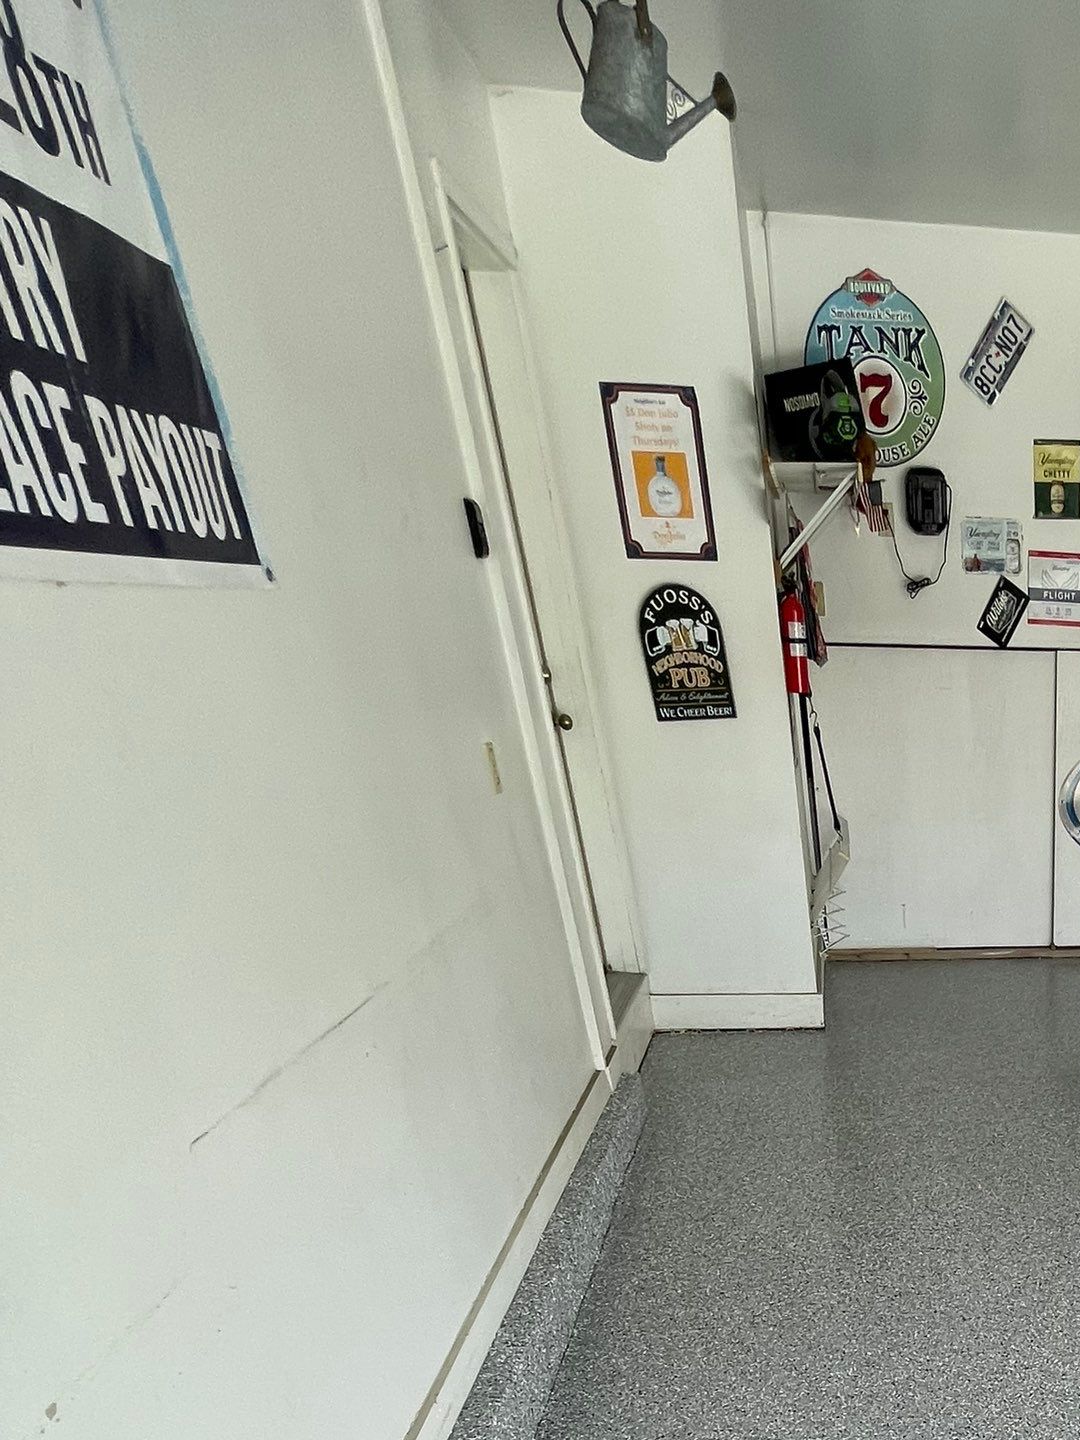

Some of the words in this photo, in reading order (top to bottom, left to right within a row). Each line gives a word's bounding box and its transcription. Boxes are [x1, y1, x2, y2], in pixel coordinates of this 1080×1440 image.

[0, 0, 112, 187] 8TH
[830, 307, 883, 320] Smokestack
[884, 309, 913, 321] Series
[816, 323, 931, 380] TANK
[859, 372, 893, 428] 7
[912, 414, 935, 449] ALE
[0, 369, 110, 523] ACE
[84, 394, 242, 541] PAYOUT
[643, 588, 714, 624] FUOSS'S
[1043, 591, 1077, 601] FLIGHT
[651, 651, 724, 676] NEIGHBORHOOD
[668, 666, 711, 688] PUB
